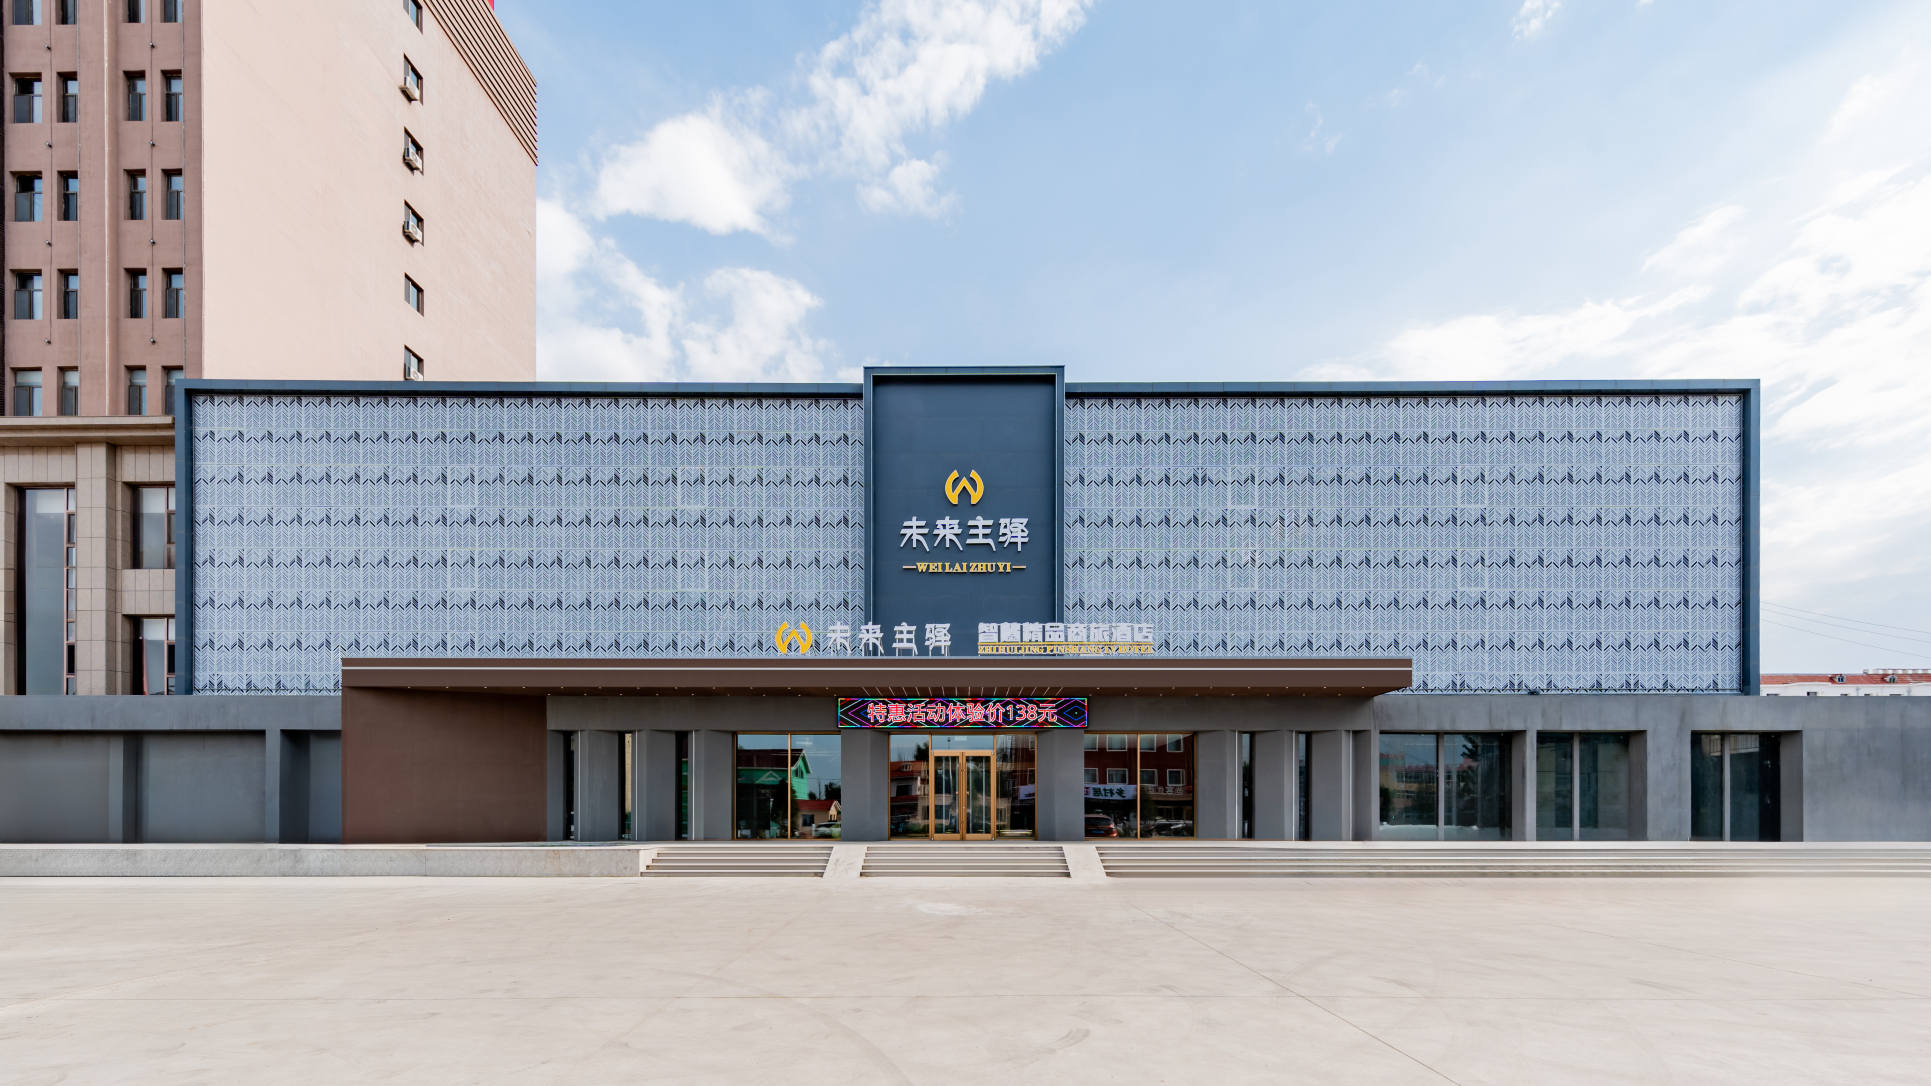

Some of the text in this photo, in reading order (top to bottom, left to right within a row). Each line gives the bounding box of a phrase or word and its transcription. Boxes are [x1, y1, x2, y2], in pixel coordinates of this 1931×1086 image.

[900, 516, 1029, 552] 未来主驿
[916, 562, 943, 573] WEI
[944, 562, 967, 573] LAI
[826, 622, 952, 654] 未来主驿
[978, 622, 1153, 642] 智慧精品商旅酒店
[1118, 645, 1154, 654] HOTEL
[867, 703, 1058, 722] 特惠活动体验价138元
